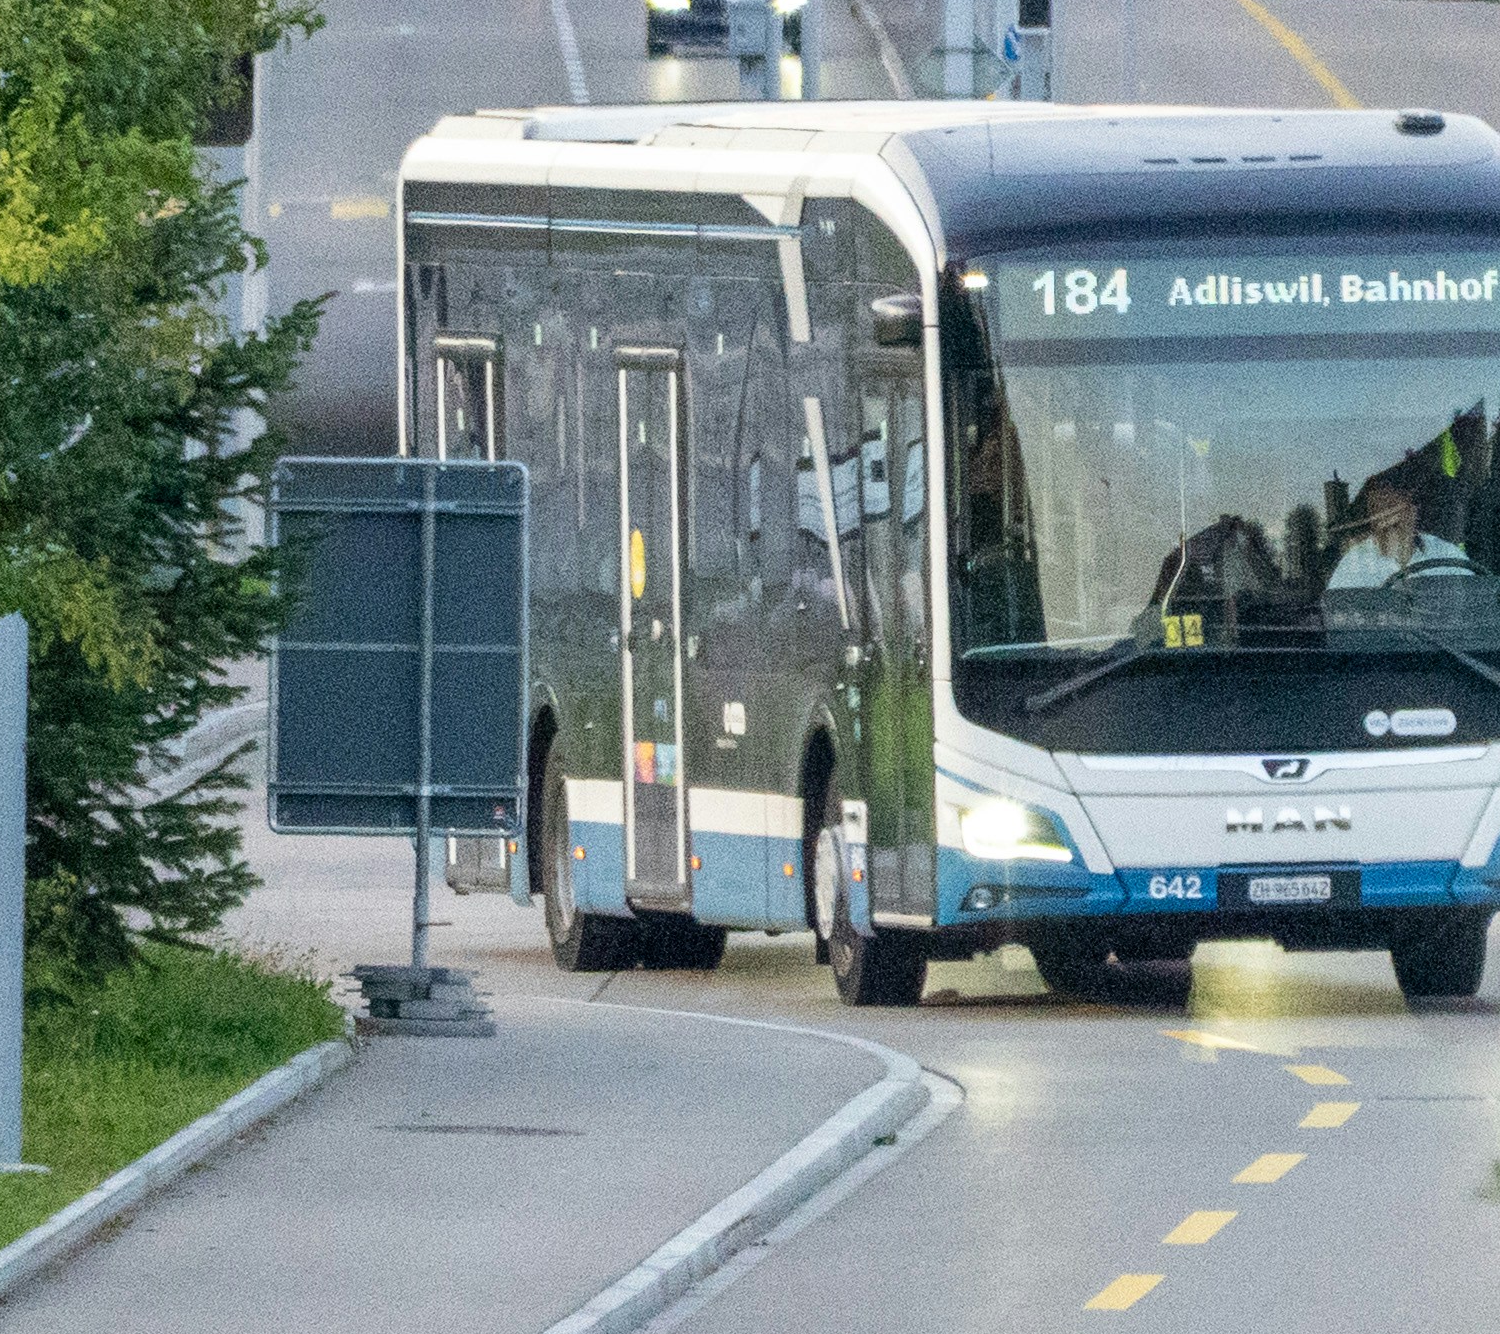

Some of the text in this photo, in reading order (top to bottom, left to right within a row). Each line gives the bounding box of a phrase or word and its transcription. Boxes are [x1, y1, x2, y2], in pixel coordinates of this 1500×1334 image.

[1033, 269, 1499, 315] 184 Adliswil, Bahnhof
[1225, 806, 1351, 834] MAN
[1149, 875, 1203, 900] 642
